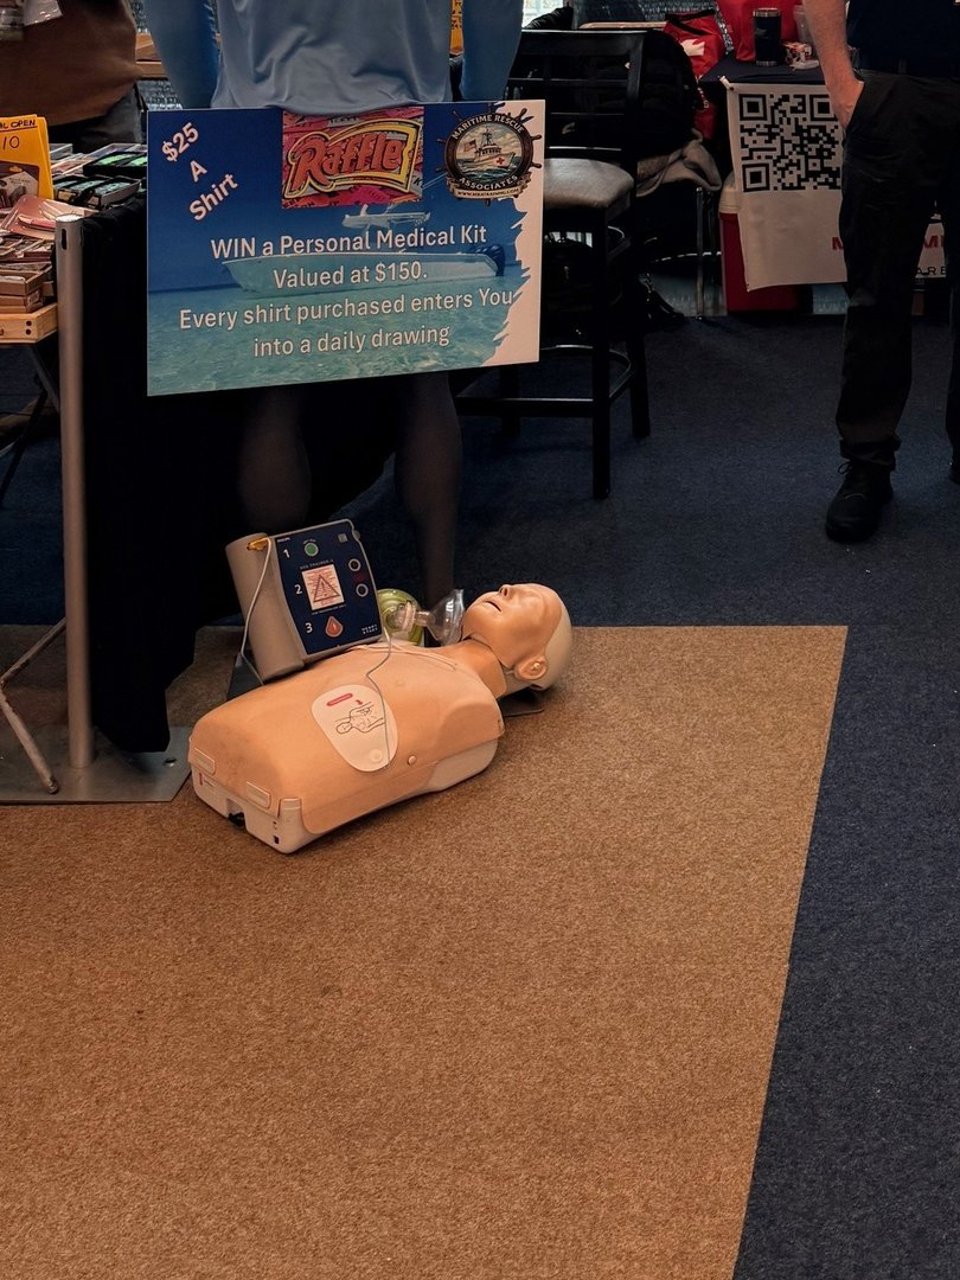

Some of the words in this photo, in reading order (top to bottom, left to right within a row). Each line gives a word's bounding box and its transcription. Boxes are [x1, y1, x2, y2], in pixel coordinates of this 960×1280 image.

[161, 122, 199, 162] $25
[451, 115, 492, 140] MARITIME
[494, 115, 525, 133] RESCUE
[190, 160, 207, 182] A
[292, 132, 405, 191] Raffle
[189, 174, 238, 221] Shirt
[459, 176, 518, 191] ASSOCIATES
[211, 237, 256, 259] WIN
[262, 241, 274, 257] a
[280, 231, 371, 255] Personal
[377, 225, 456, 249] Medical
[461, 224, 487, 244] Kit
[274, 265, 344, 289] Valued
[351, 266, 370, 283] at
[375, 260, 428, 282] $150.
[180, 308, 238, 331] Every
[243, 304, 292, 325] shirt
[297, 294, 405, 324] purchased
[411, 291, 473, 311] enters
[478, 287, 514, 307] You
[253, 336, 294, 357] into
[300, 338, 312, 353] a
[317, 330, 366, 354] daily
[371, 325, 450, 349] drawing
[283, 548, 291, 559] 1
[294, 584, 303, 595] 2
[305, 622, 313, 634] 3
